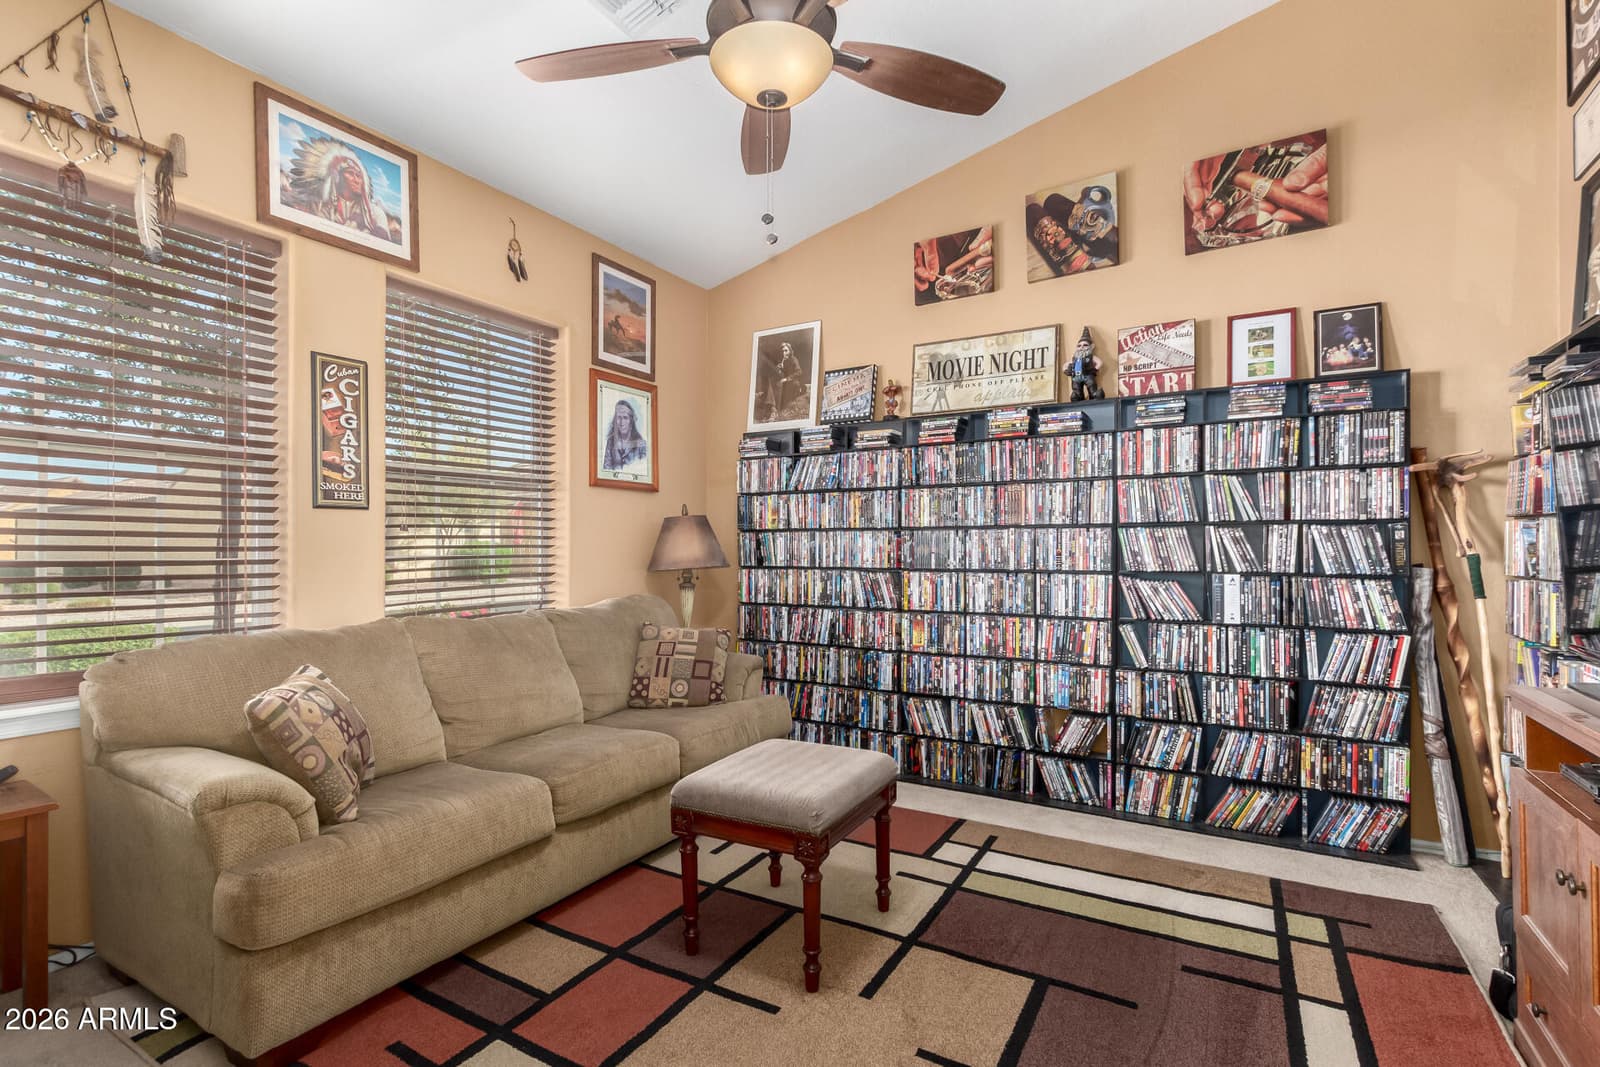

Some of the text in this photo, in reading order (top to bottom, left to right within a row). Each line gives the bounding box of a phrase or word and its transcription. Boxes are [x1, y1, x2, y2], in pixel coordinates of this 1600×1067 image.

[324, 364, 360, 382] Cuban
[927, 346, 1049, 382] MOVIE NIGHT
[1133, 362, 1158, 371] SCRIPT
[1118, 370, 1196, 398] START
[338, 378, 361, 479] CIGARS
[320, 481, 364, 492] SMOKED
[334, 491, 364, 501] HERE
